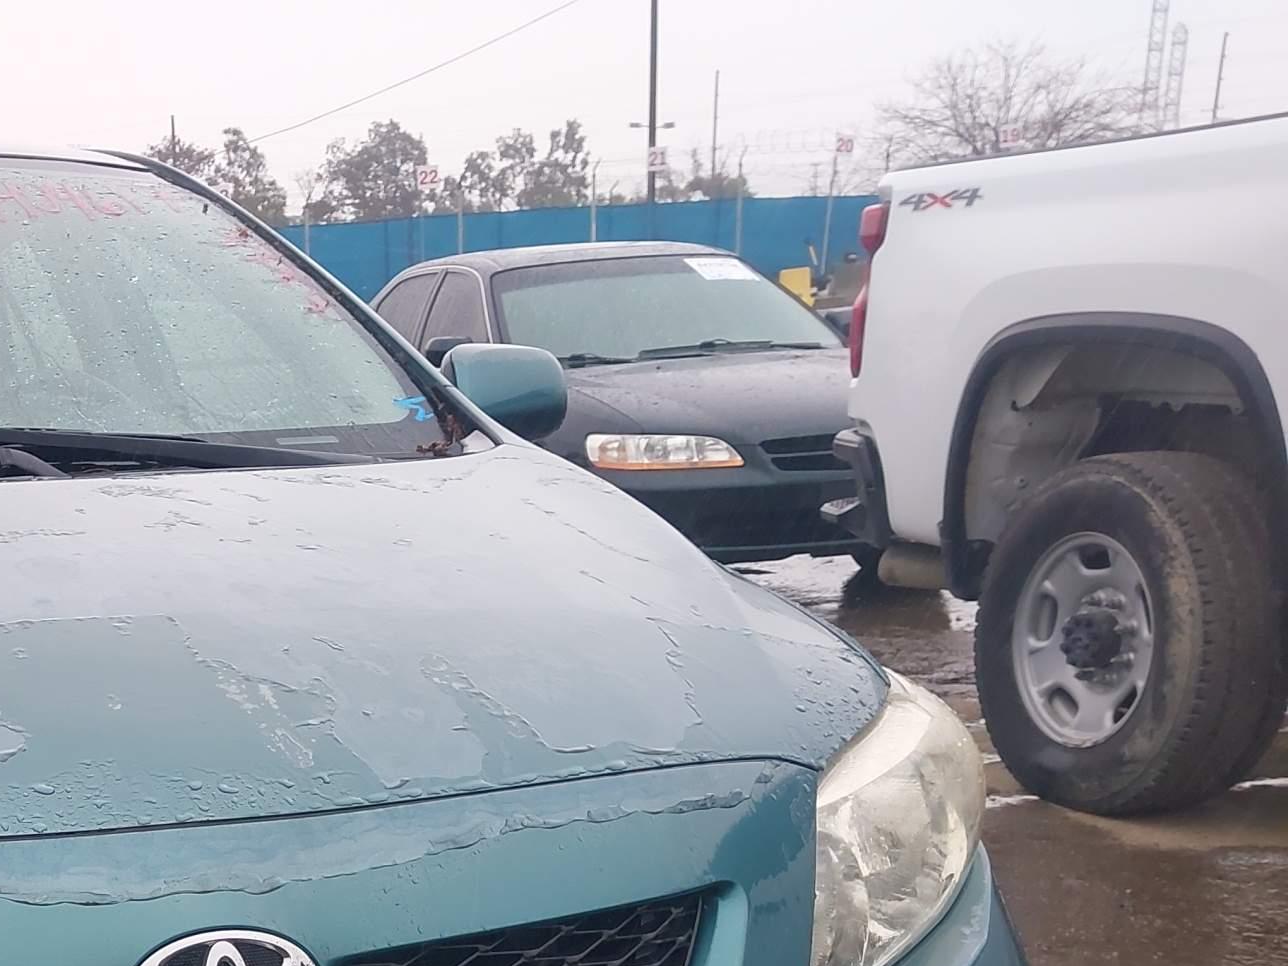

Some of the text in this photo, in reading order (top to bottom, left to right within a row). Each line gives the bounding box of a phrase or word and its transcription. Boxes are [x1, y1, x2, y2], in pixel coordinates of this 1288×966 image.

[836, 138, 854, 152] 20
[649, 151, 666, 166] 21
[419, 169, 439, 185] 22
